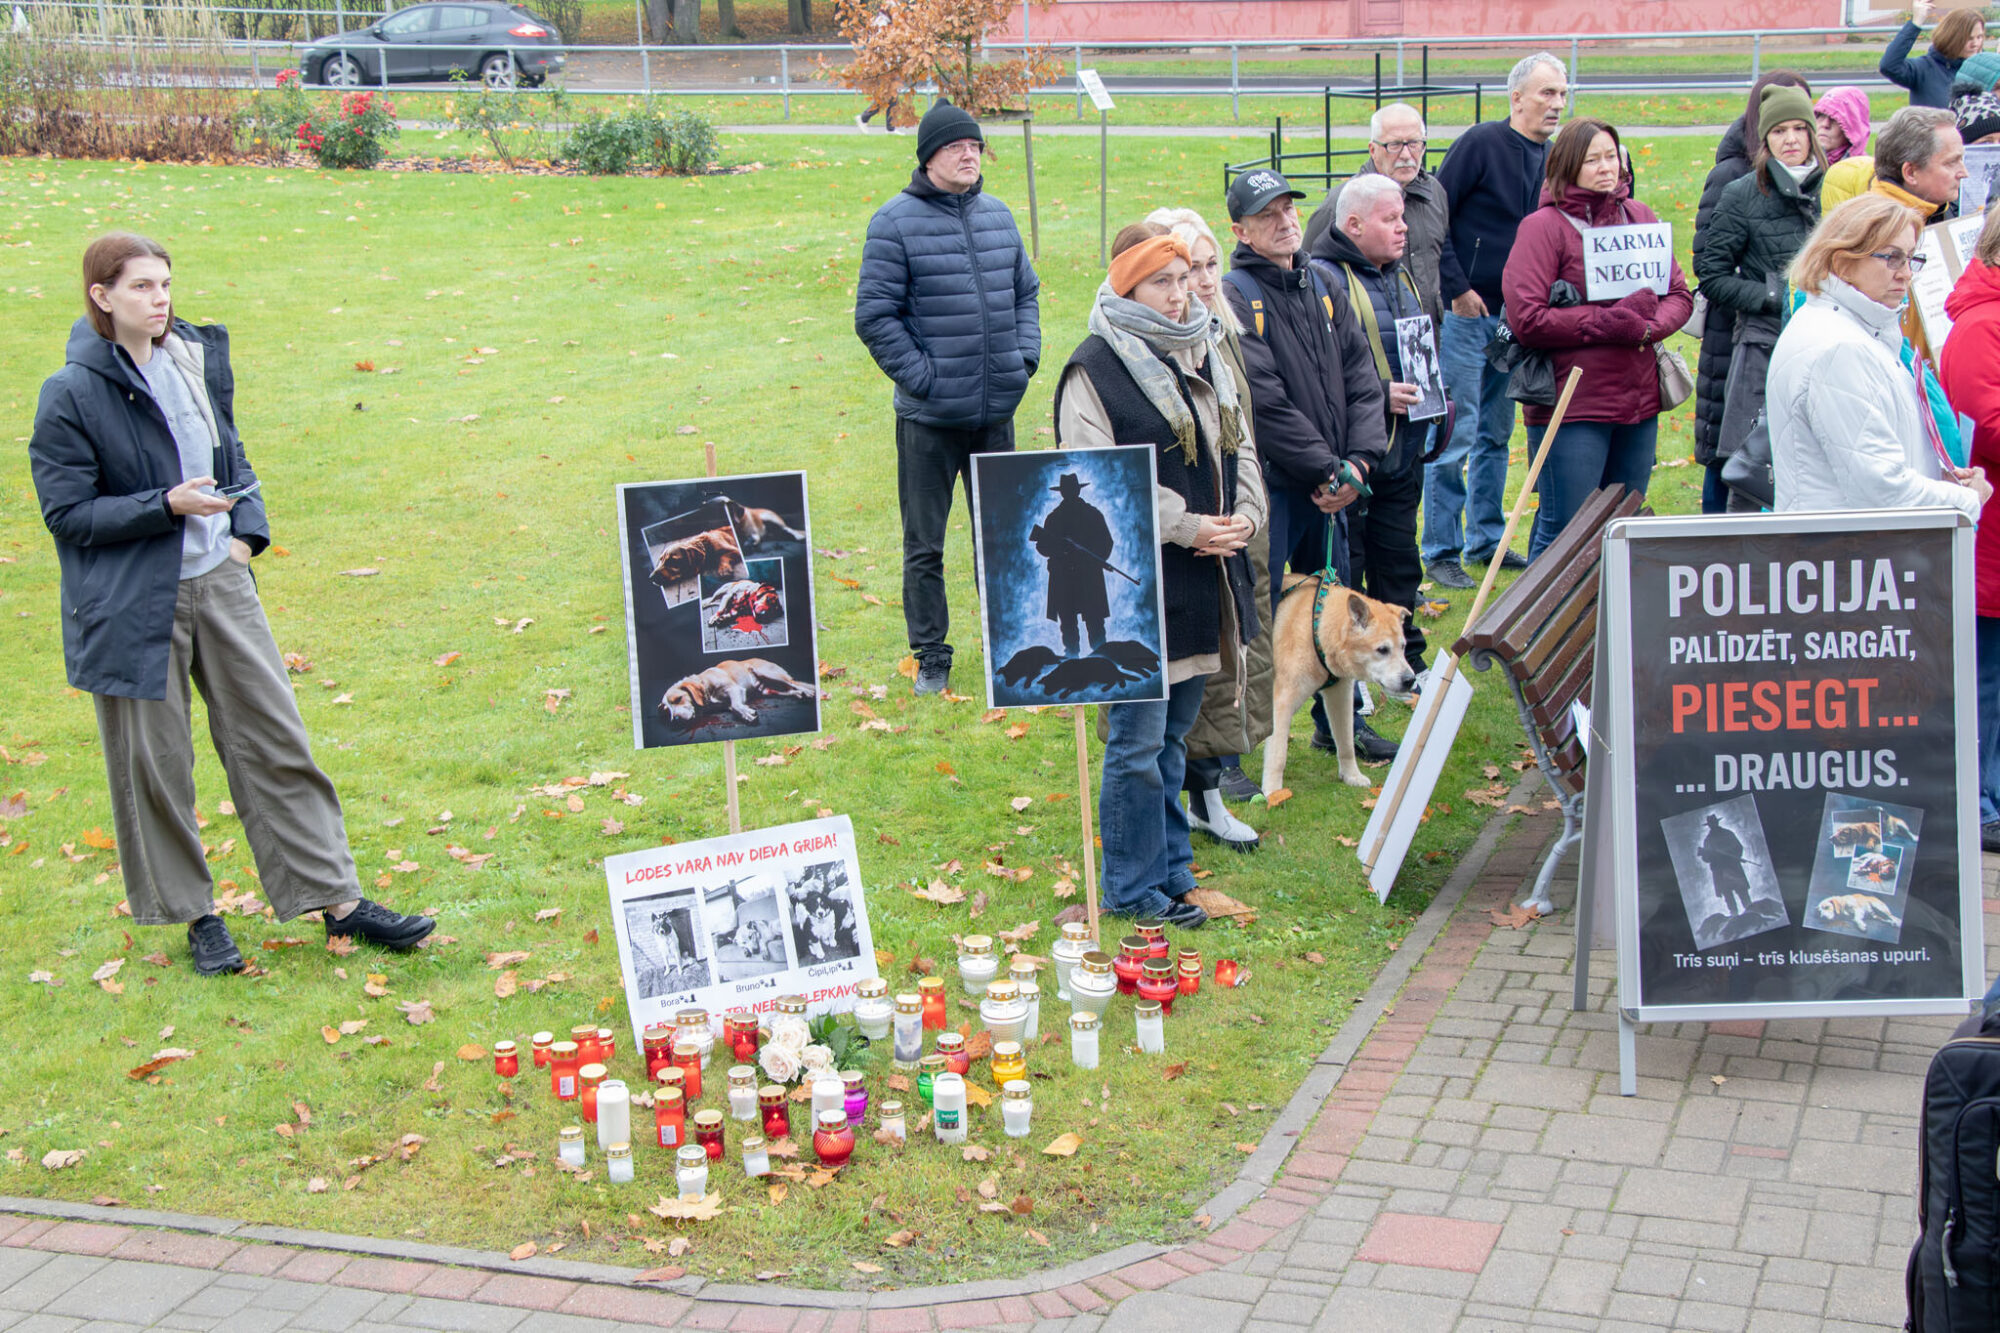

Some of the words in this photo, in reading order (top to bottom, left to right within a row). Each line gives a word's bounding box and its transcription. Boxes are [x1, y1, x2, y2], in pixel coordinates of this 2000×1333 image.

[1592, 233, 1665, 253] KARMA
[1594, 262, 1665, 283] NEGUĻ
[1668, 557, 1916, 618] POLICIJA:
[1670, 628, 1797, 665] PALĪDZĒT,
[1804, 625, 1916, 662] SARGĀT,
[1672, 677, 1919, 733] PIESEGT...
[626, 863, 672, 885] LODES
[676, 855, 712, 875] VARA
[716, 851, 745, 867] NAV
[749, 842, 789, 862] DIEVA
[793, 833, 837, 854] GRIBA!
[1673, 953, 1702, 968] Trīs
[1706, 952, 1739, 971] suņi
[1758, 951, 1784, 966] trīs
[1789, 948, 1878, 965] klusēšanas
[1883, 947, 1931, 966] upuri.
[735, 981, 760, 993] Bruno
[660, 997, 680, 1008] Bora
